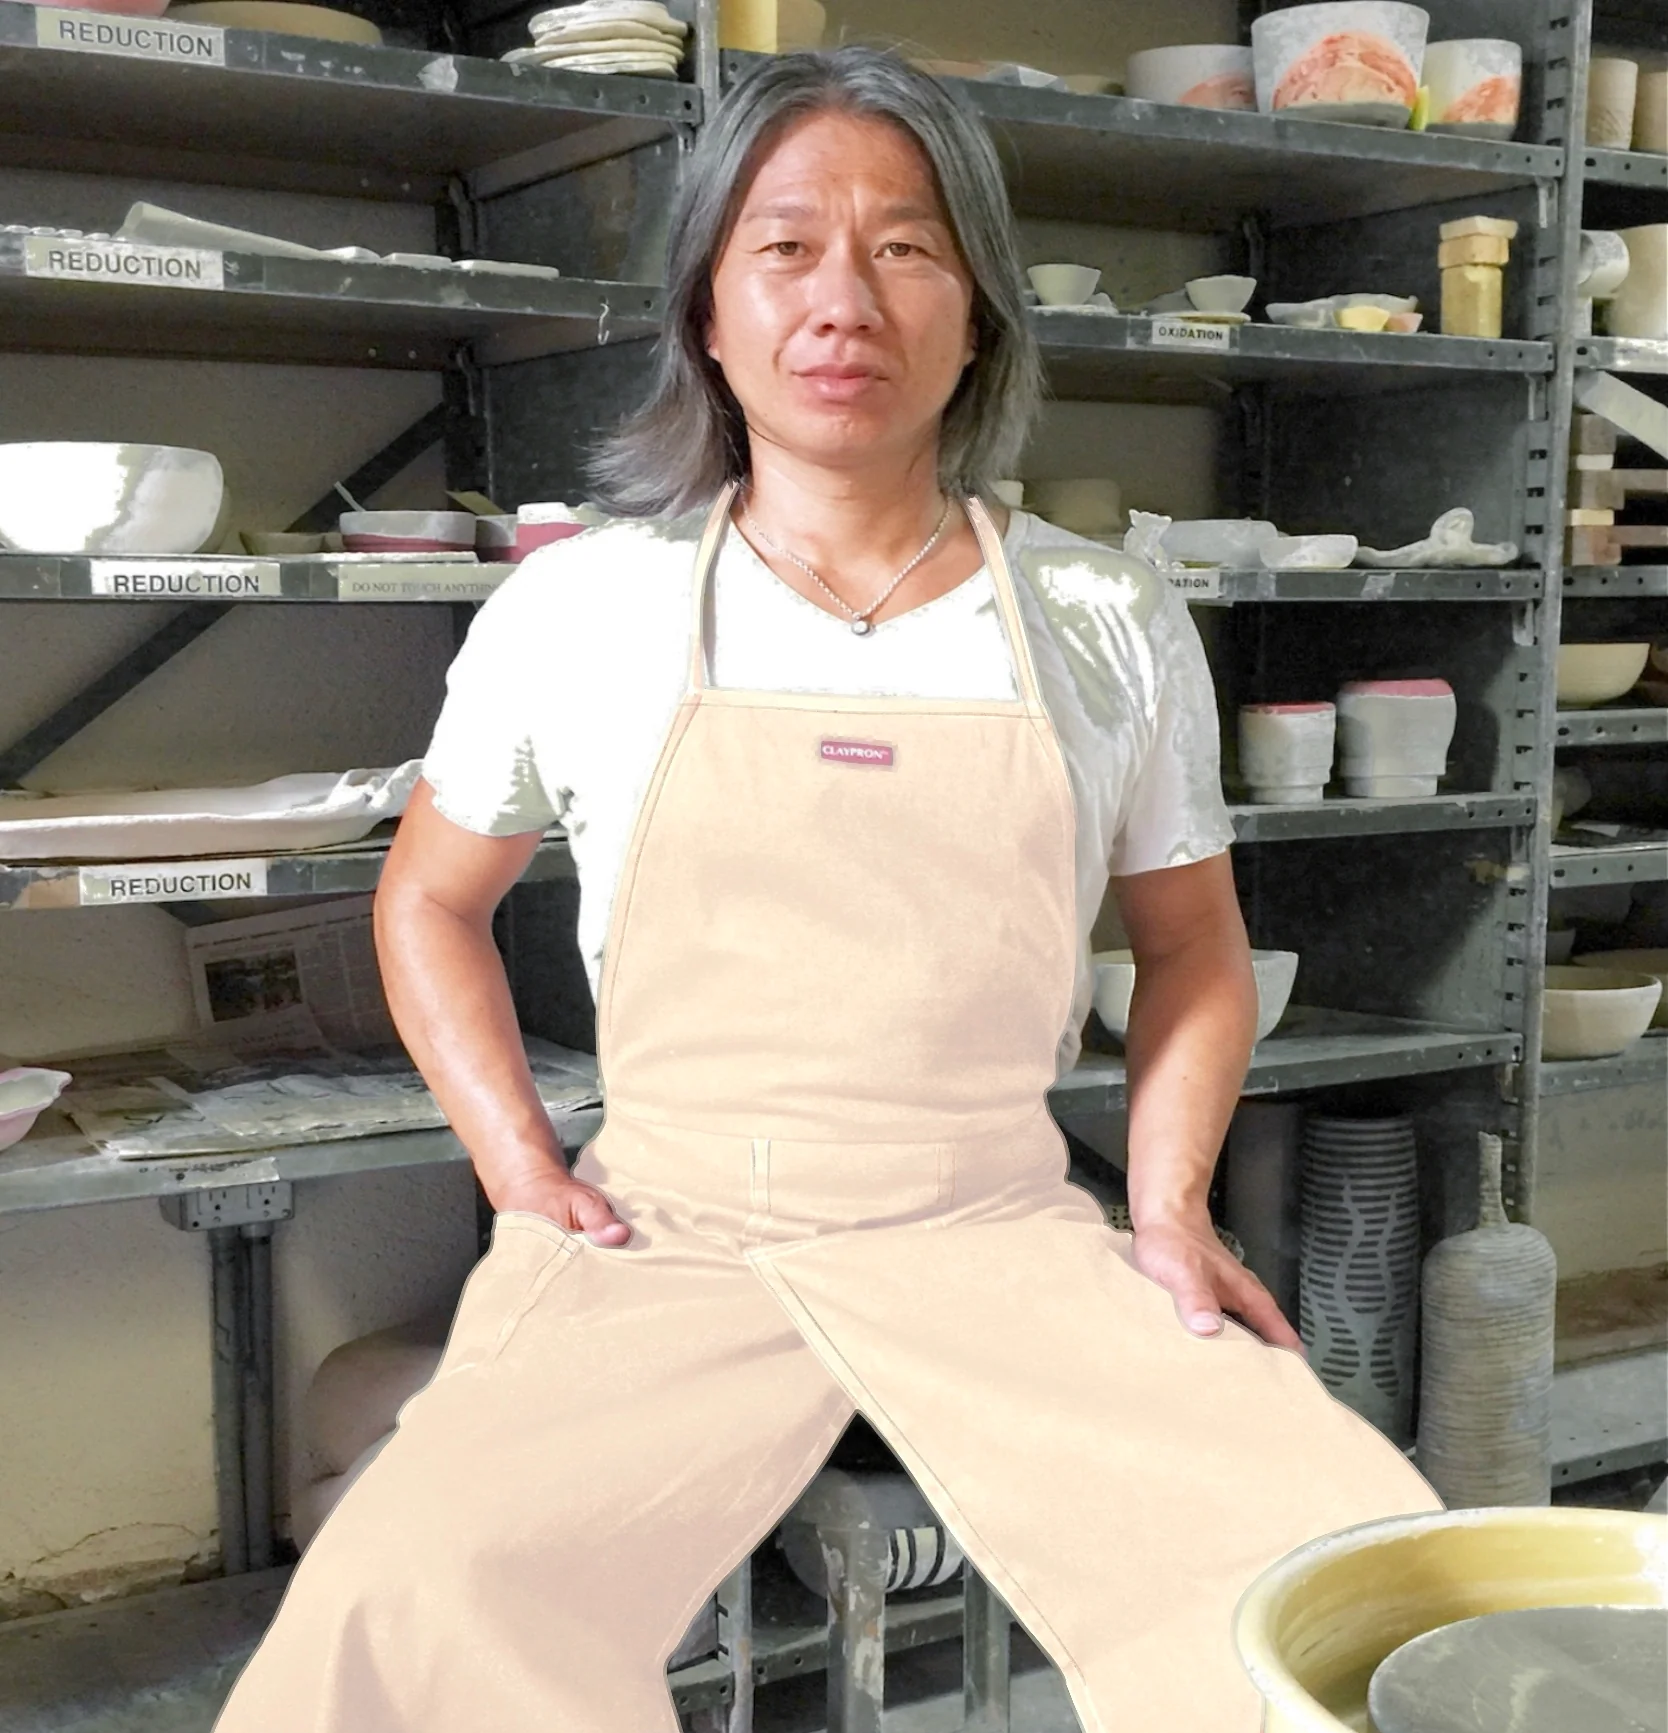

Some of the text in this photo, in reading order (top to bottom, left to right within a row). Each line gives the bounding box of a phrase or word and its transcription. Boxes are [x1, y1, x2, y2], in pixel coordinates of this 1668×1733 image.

[59, 20, 213, 57] REDUCTION
[49, 250, 201, 279] REDUCTION
[1158, 326, 1223, 341] OXIDATION
[113, 574, 260, 593] REDUCTION
[352, 582, 371, 593] DO
[373, 582, 398, 593] NOT
[444, 583, 502, 594] ANYTHIN
[110, 872, 252, 897] REDUCTION
